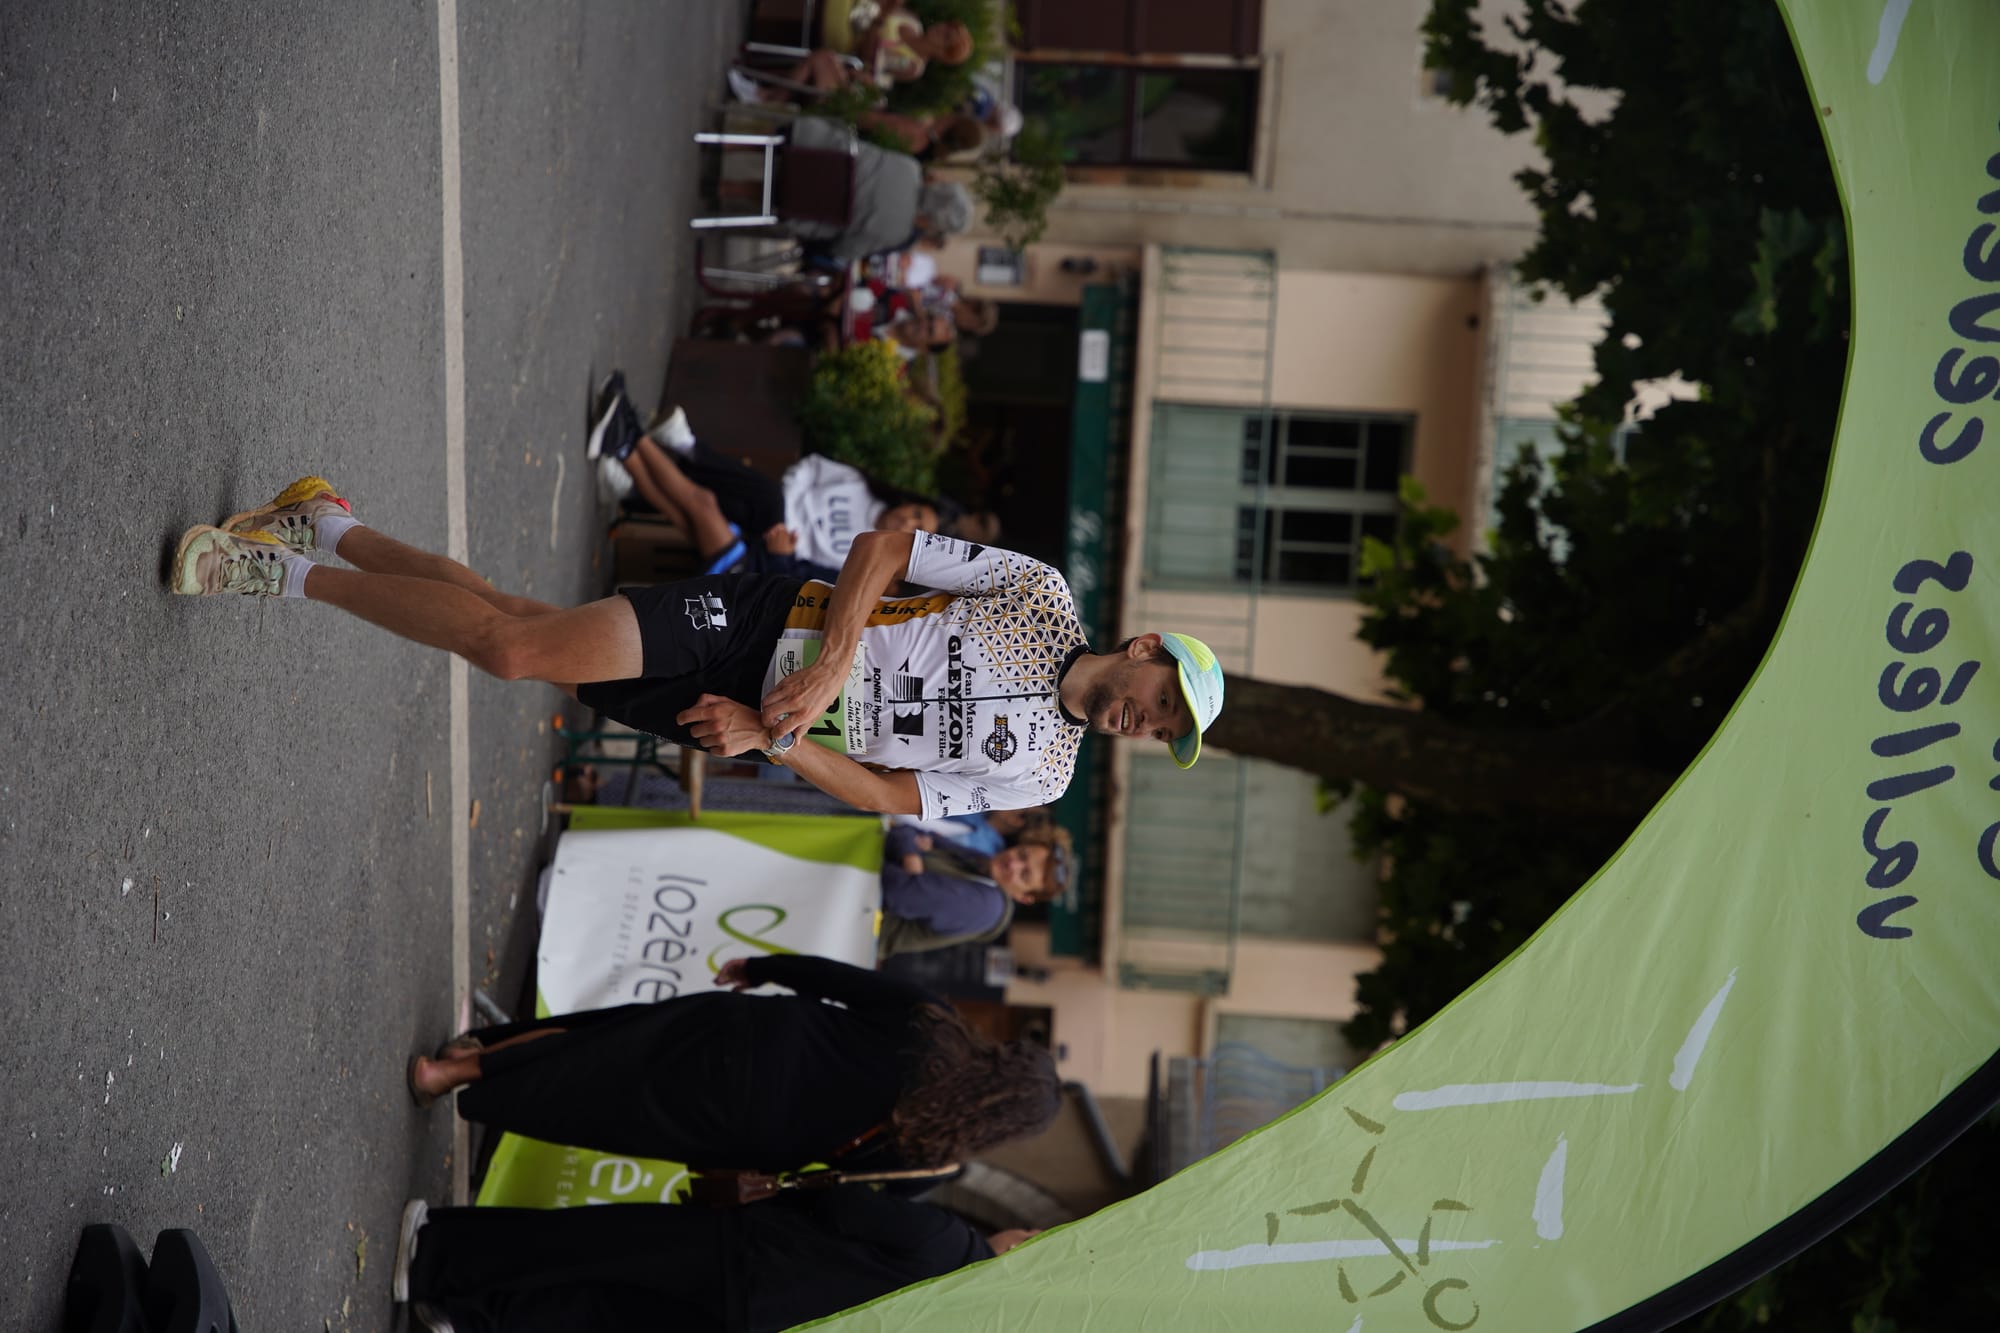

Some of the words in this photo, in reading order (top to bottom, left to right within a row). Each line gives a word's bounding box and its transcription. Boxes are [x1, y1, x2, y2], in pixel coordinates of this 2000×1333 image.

[828, 496, 851, 555] LULU
[874, 667, 882, 703] BONNET
[962, 661, 976, 696] Jean
[938, 687, 946, 711] Fils
[948, 635, 963, 760] GLEYZON
[872, 705, 882, 738] Hygiène
[938, 714, 945, 728] et
[966, 702, 976, 738] Marc
[1028, 722, 1037, 752] POLI
[633, 873, 709, 1002] lozère
